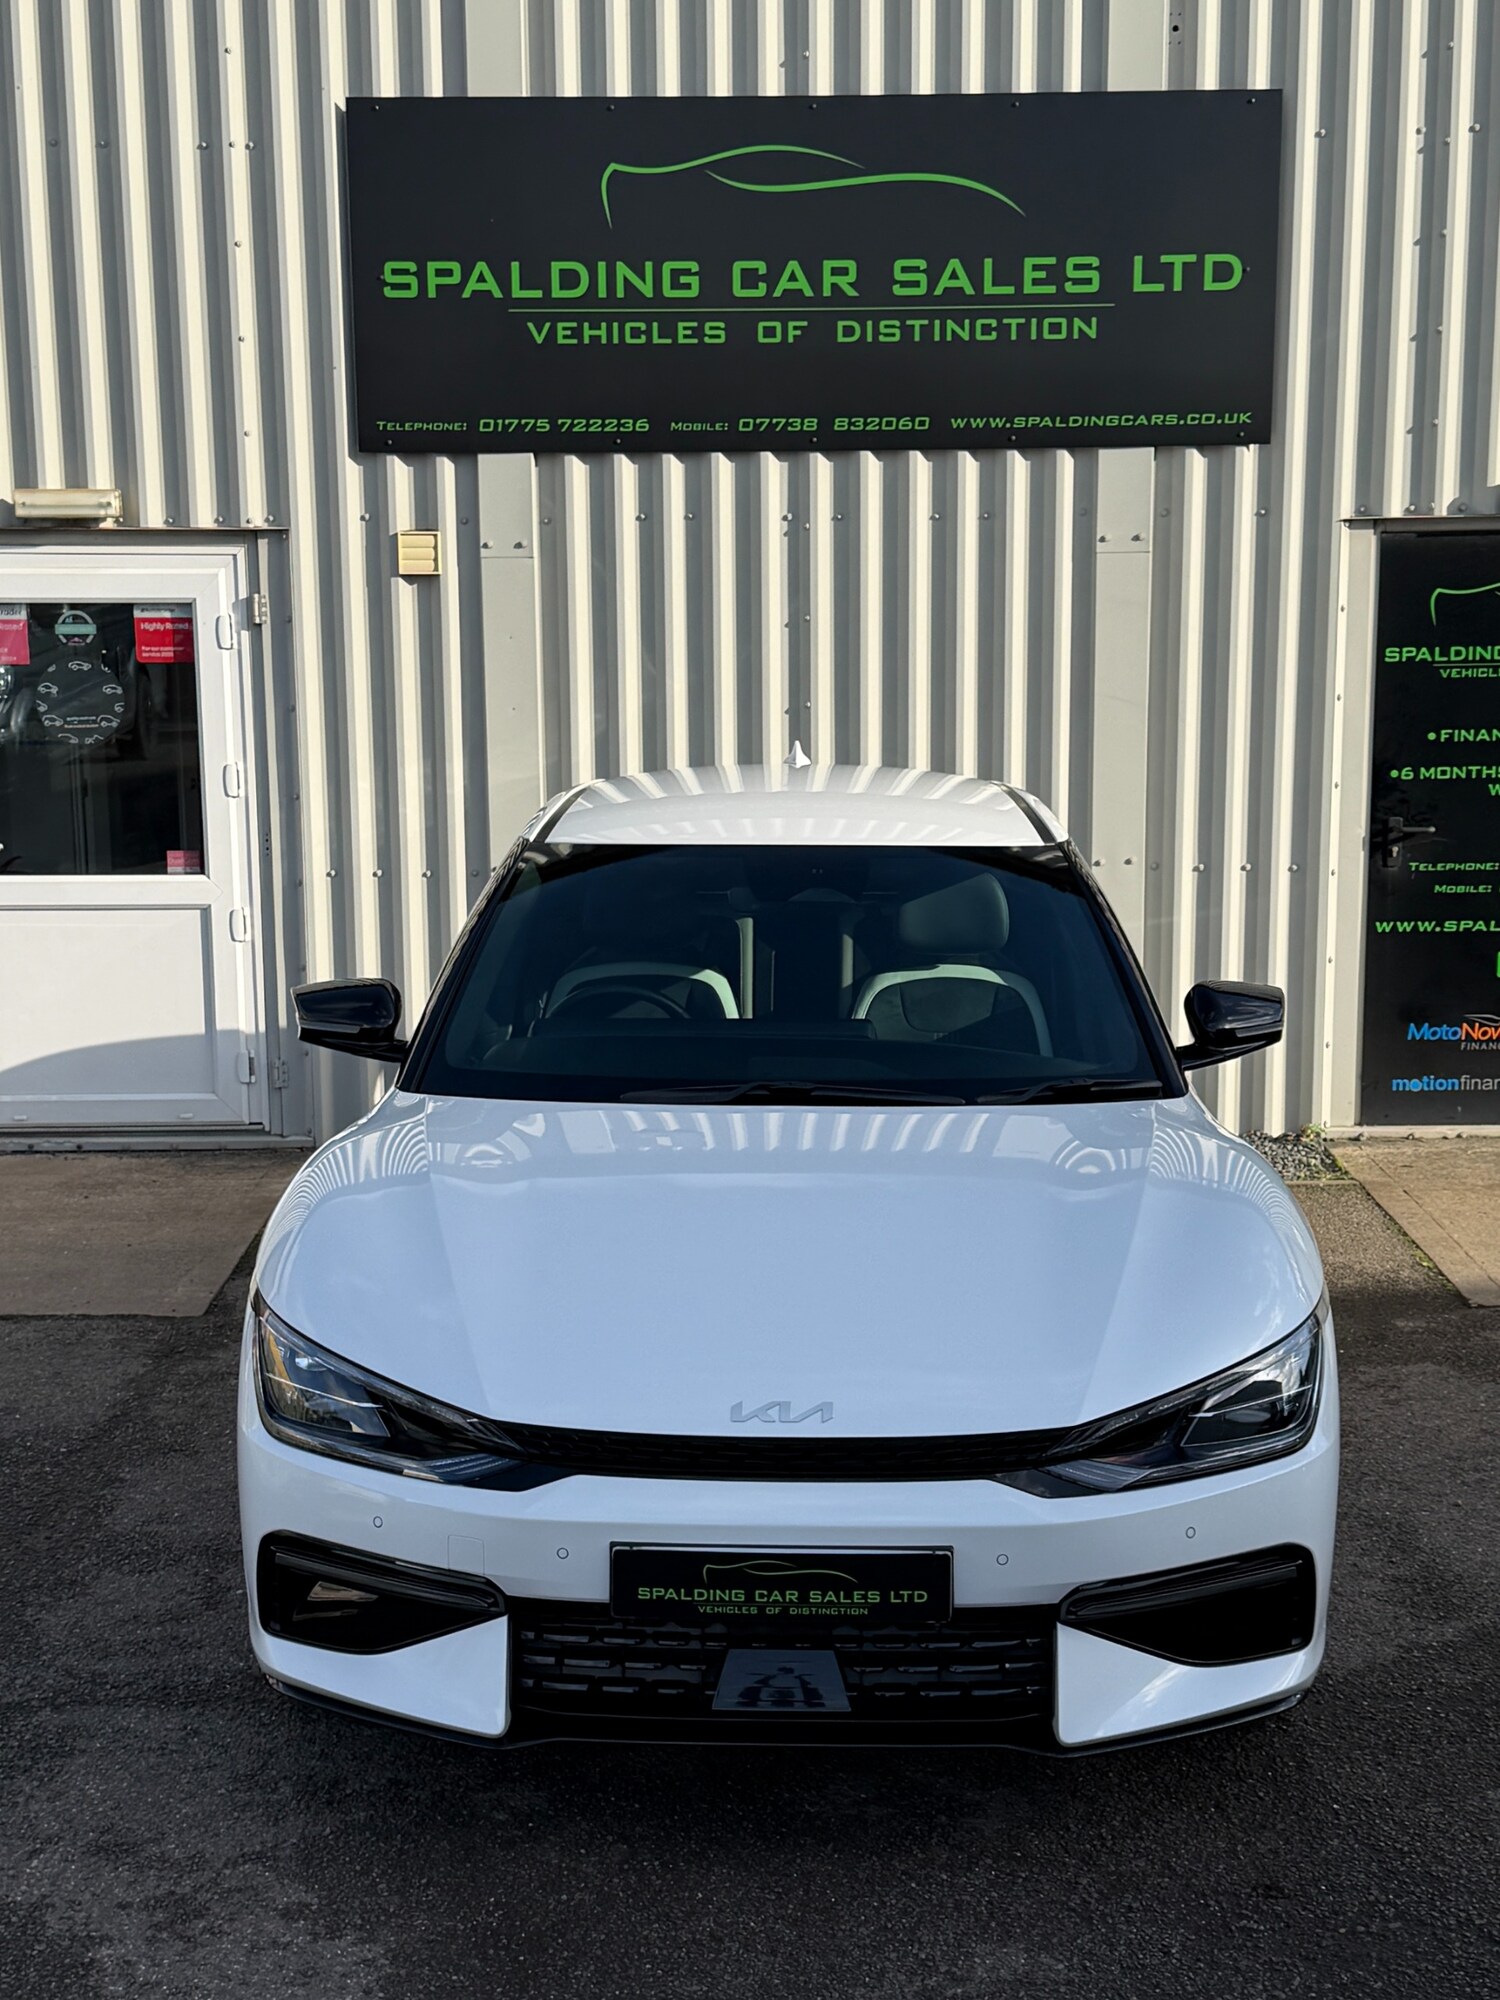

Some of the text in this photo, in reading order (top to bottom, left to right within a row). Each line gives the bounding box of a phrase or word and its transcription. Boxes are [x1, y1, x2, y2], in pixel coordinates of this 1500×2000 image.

[383, 253, 1243, 299] SPALDING CAR SALES LTD
[527, 316, 1098, 345] VEHICLES OF DISTINCTION
[376, 411, 1252, 433] TELEPHONE: 01775 722236 MOBILE: 07738 832060 WWW.SPALDINGCARS.CO.UK
[1439, 667, 1500, 679] VEHICL
[1400, 765, 1500, 780] 6 MONTH
[1408, 862, 1499, 871] TELEPHONE:
[1433, 884, 1492, 893] MOBILE:
[729, 1400, 835, 1424] KIA
[637, 1587, 928, 1604] SPALDING CAR SALES LTD
[697, 1605, 869, 1616] VEHICLES OF DISTINCTION
